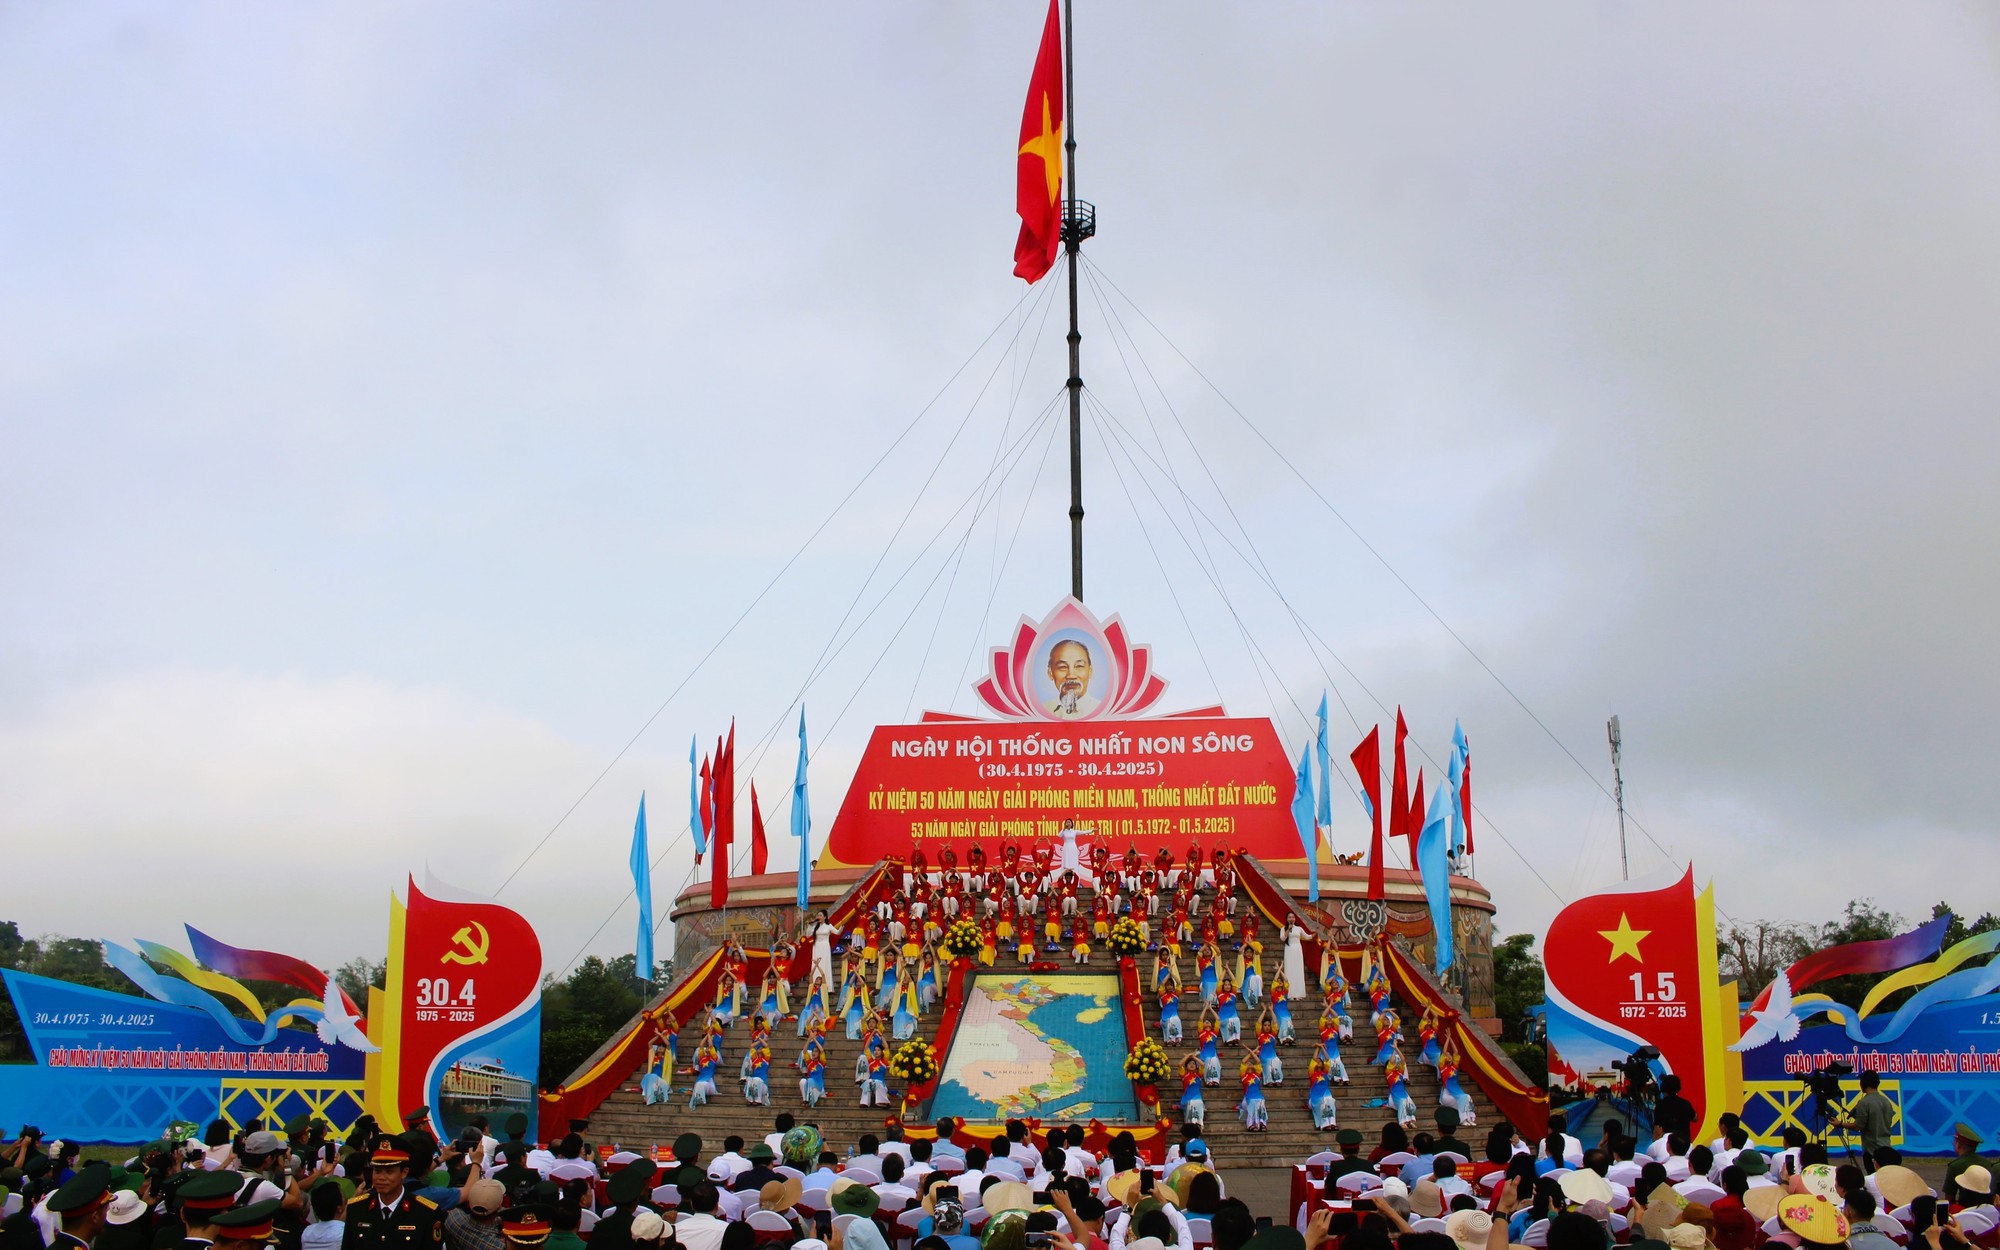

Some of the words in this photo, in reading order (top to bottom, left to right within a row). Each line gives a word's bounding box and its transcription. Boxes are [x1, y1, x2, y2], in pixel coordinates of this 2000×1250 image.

[891, 736, 949, 757] NGÀY
[955, 735, 992, 762] HỘI
[998, 732, 1073, 757] THỐNG
[1079, 731, 1132, 755] NHẤT
[1138, 736, 1185, 754] NON
[1192, 731, 1254, 753] SÔNG
[869, 784, 884, 810] KỶ
[887, 788, 917, 814] NIỆM
[920, 791, 934, 809] 50
[938, 787, 965, 809] NĂM
[968, 787, 999, 809] NGÀY
[1003, 782, 1026, 809] GIẢI
[1030, 786, 1070, 809] PHÓNG
[1073, 783, 1104, 808] MIỀN
[1107, 789, 1139, 810] NAM,
[1142, 782, 1180, 807] THỐNG
[1184, 781, 1215, 806] NHẤT
[1218, 780, 1240, 806] ĐẤT
[1244, 780, 1276, 805] NƯỚC
[911, 822, 923, 838] 53
[925, 819, 948, 838] NĂM
[950, 818, 977, 837] NGÀY
[979, 815, 998, 837] GIẢI
[1001, 818, 1034, 837] PHÓNG
[1036, 814, 1058, 837] TỈNH
[1097, 819, 1112, 838] TRỊ
[416, 978, 476, 1006] 30.4
[1629, 972, 1676, 1001] 1.5
[33, 1013, 90, 1025] 30.4.1975
[97, 1013, 155, 1026] 30.4.2025
[416, 1010, 438, 1021] 1975
[449, 1011, 475, 1022] 2025
[1620, 1006, 1646, 1018] 1972
[1657, 1006, 1687, 1018] 2025
[49, 1045, 68, 1068] CHÀO
[68, 1044, 90, 1068] MỪNG
[90, 1042, 102, 1068] KỶ
[101, 1046, 119, 1072] NIỆM
[121, 1049, 130, 1068] 50
[130, 1047, 148, 1069] NĂM
[148, 1047, 168, 1069] NGÀY
[168, 1044, 184, 1069] GIẢI
[184, 1047, 208, 1070] PHÓNG
[209, 1045, 228, 1071] MIỀN
[228, 1052, 248, 1073] NAM,
[249, 1046, 273, 1071] THỐNG
[273, 1046, 292, 1071] NHẤT
[292, 1047, 307, 1072] ĐẤT
[307, 1048, 329, 1072] NƯỚC
[1784, 1050, 1812, 1074] CHÀO
[1889, 1053, 1904, 1073] 53
[1904, 1049, 1930, 1073] NĂM
[1930, 1049, 1958, 1073] NGÀY
[1960, 1045, 1981, 1073] GIẢI
